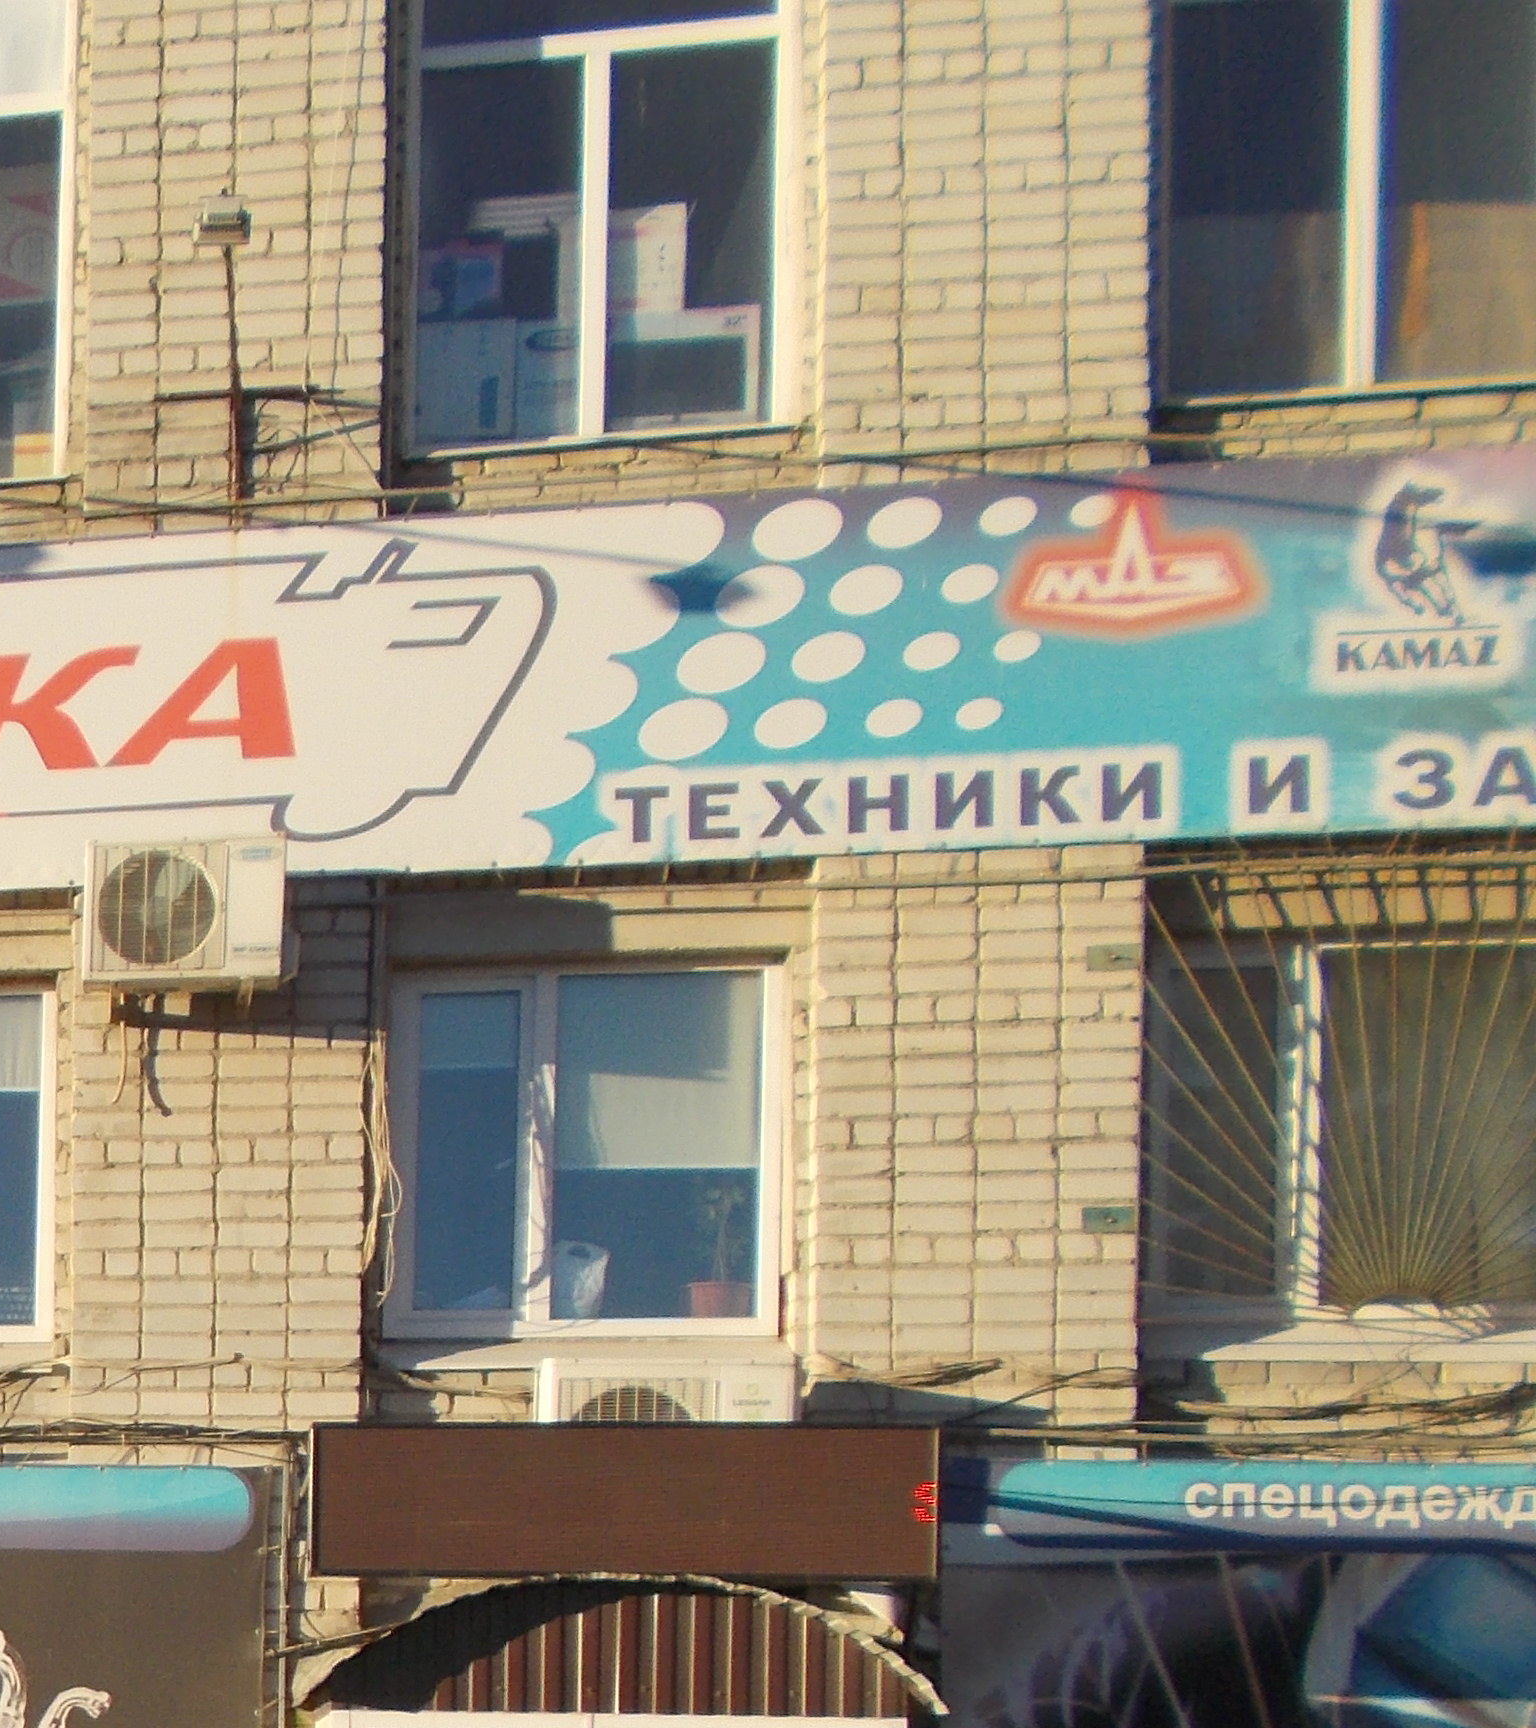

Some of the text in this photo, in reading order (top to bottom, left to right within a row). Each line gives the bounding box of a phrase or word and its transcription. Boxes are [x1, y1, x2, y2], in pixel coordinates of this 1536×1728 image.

[1337, 635, 1500, 673] KAMAZ
[616, 747, 1536, 844] ТЕХНИКИ И ЗА
[1184, 1481, 1536, 1529] спецодежд
